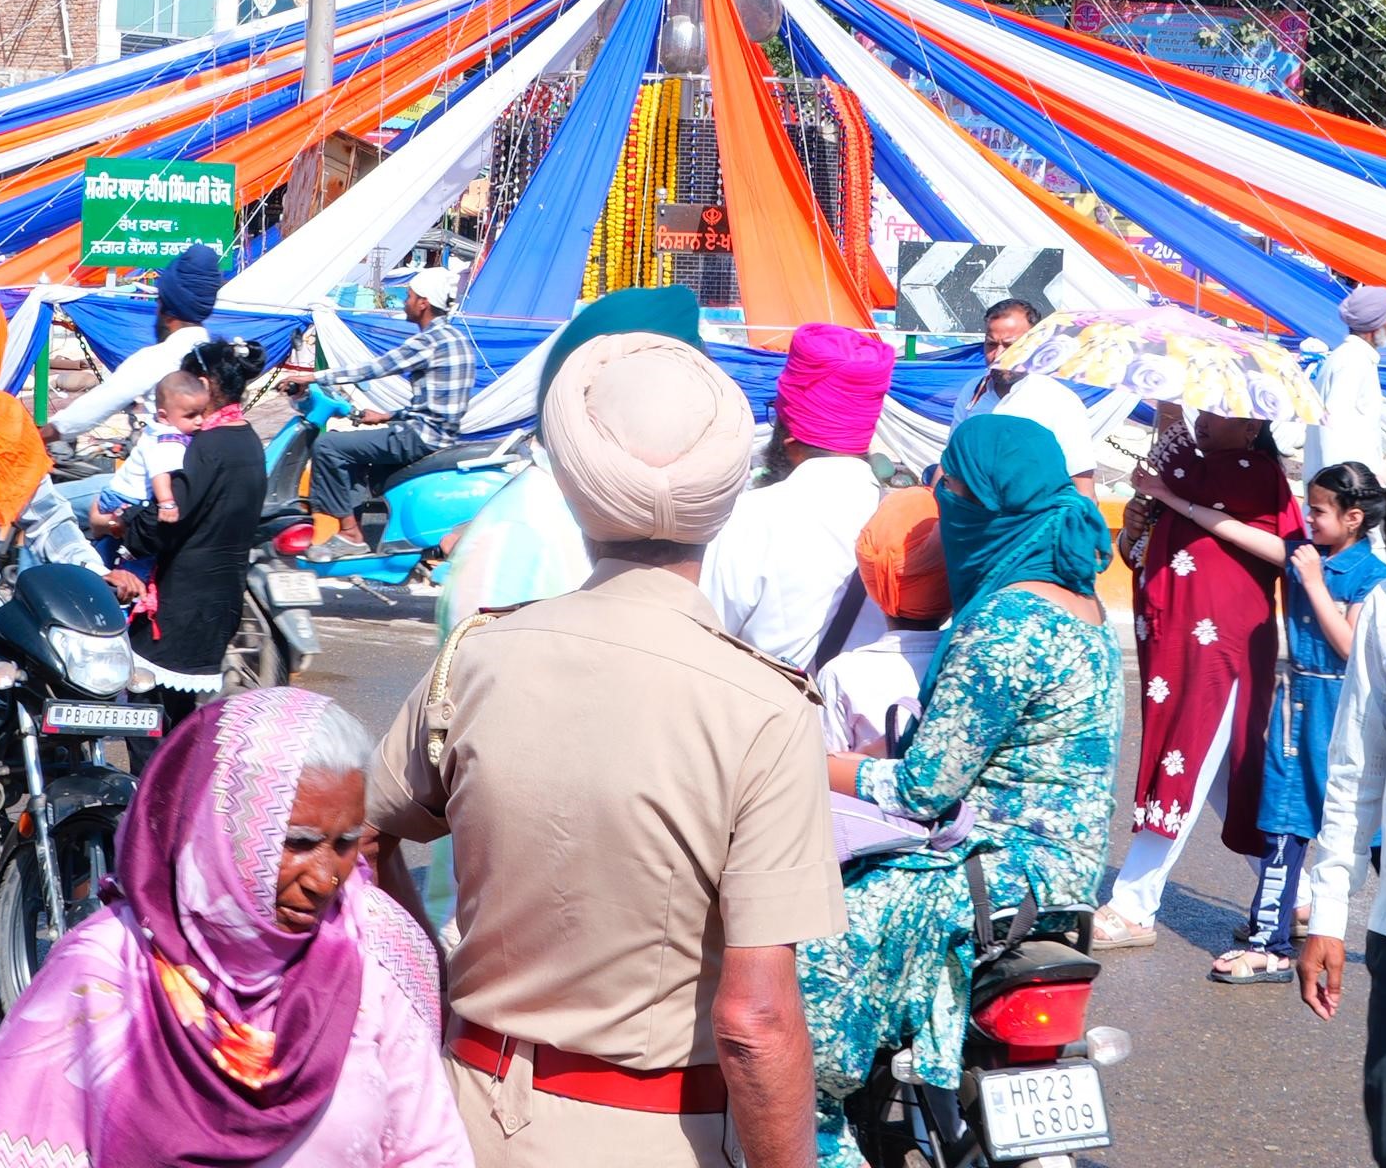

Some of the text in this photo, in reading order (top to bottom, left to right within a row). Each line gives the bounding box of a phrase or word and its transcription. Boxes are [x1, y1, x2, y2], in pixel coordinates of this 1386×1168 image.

[91, 239, 125, 255] ਨਗਰ
[1009, 1074, 1073, 1106] HR23
[1014, 1103, 1095, 1138] L6809
